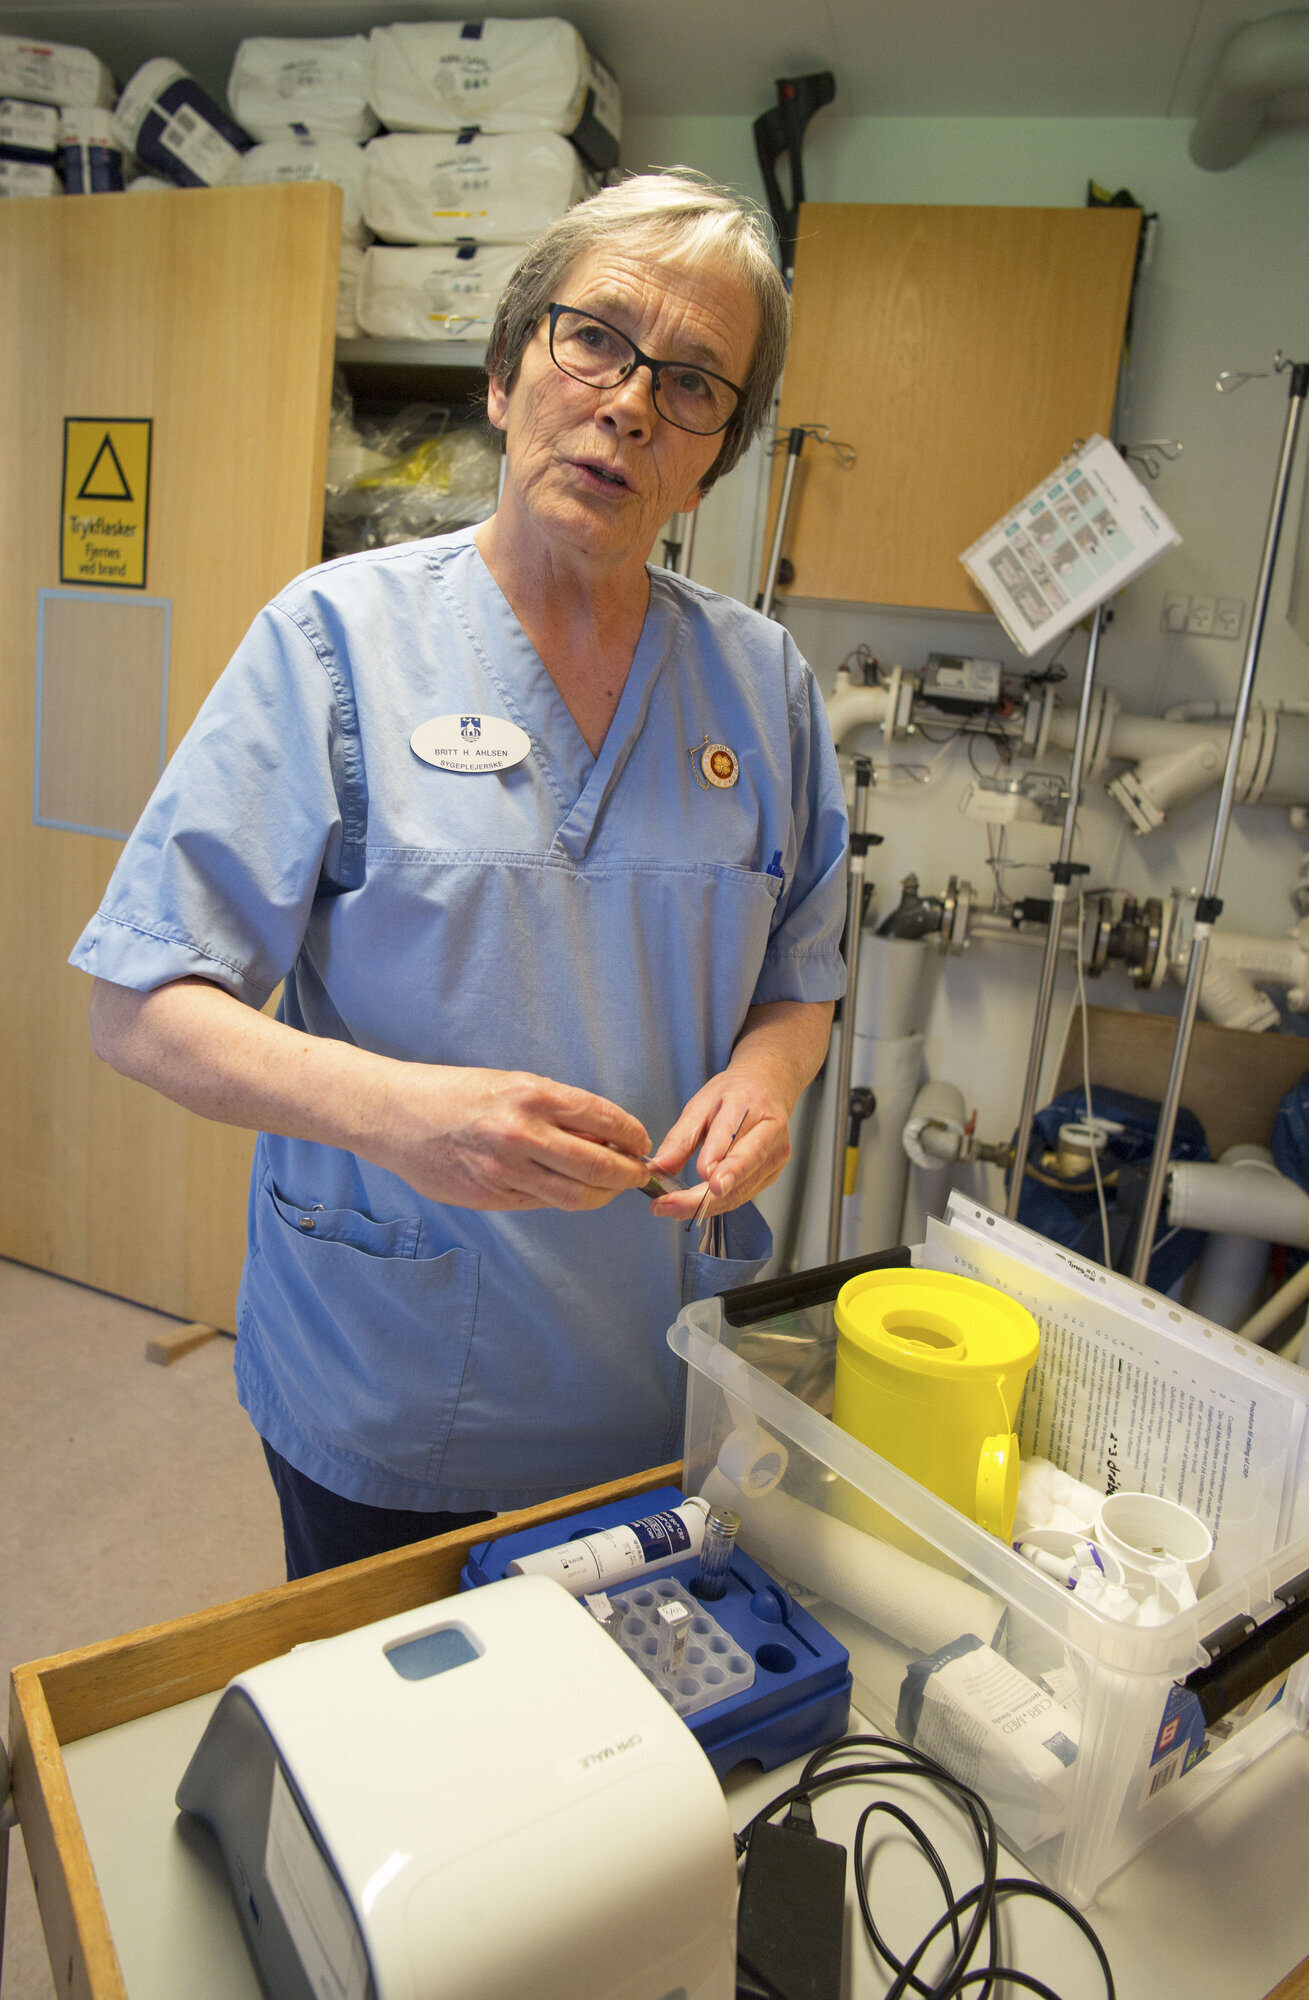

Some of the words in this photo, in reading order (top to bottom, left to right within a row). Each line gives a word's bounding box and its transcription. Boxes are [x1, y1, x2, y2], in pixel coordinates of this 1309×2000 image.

[69, 515, 137, 540] Trykflasker
[85, 543, 121, 561] Fjernes
[79, 563, 96, 575] ved
[98, 563, 126, 577] brand
[440, 760, 503, 770] SYGEPLEJERSKE
[663, 1520, 674, 1534] CRP
[675, 1526, 686, 1541] CRP
